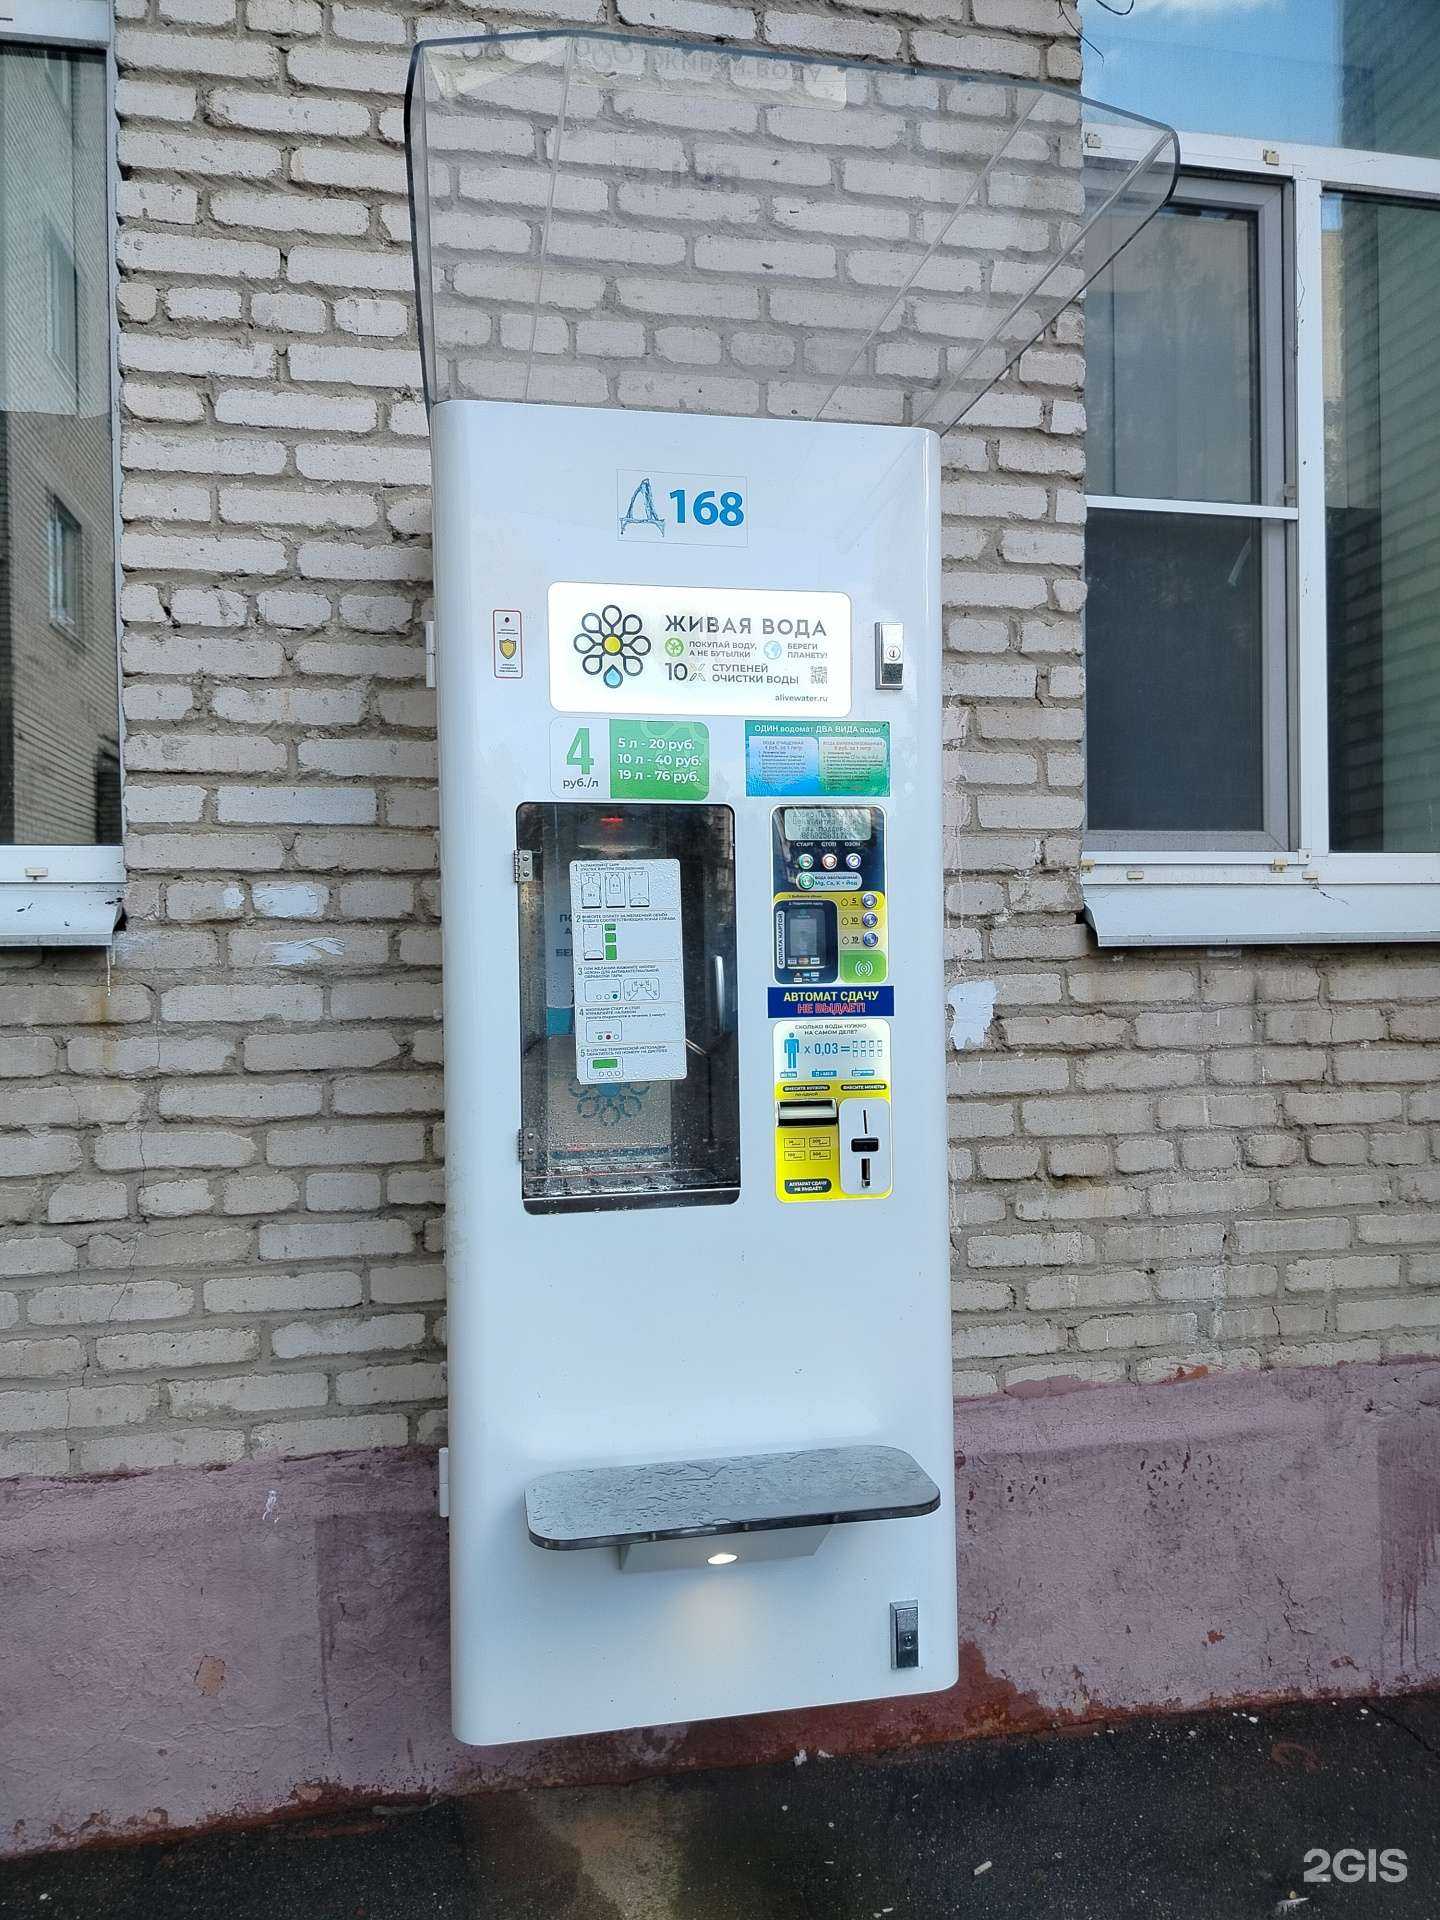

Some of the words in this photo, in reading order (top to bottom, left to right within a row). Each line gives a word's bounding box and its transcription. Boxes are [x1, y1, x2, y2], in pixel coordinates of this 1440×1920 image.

[669, 489, 744, 527] 168
[665, 614, 752, 634] ЖИВАЯ
[762, 618, 827, 639] ВОДА
[689, 640, 730, 649] ПОКУПАЙ
[732, 642, 758, 651] ВОДУ,
[787, 642, 818, 650] БЕРЕГИ
[710, 650, 751, 658] БУТЫЛКИ
[787, 651, 828, 659] ПЛАНЕТУ!
[712, 663, 768, 673] СТУПЕНЕЙ
[712, 674, 763, 683] ОЧИСТКИ
[766, 675, 799, 685] ВОДЫ
[775, 693, 829, 703] alivewater.ru
[754, 724, 779, 734] ОДИН
[815, 725, 833, 734] ДВА
[835, 725, 859, 734] ВИДА
[618, 737, 625, 748] 5
[629, 740, 637, 748] л
[649, 738, 666, 749] 20
[668, 738, 695, 750] руб.
[566, 727, 595, 775] 4
[617, 753, 632, 764] 10
[634, 755, 643, 764] л
[655, 754, 672, 765] 40
[675, 754, 702, 767] руб.
[618, 769, 632, 780] 19
[634, 771, 643, 780] л
[655, 770, 670, 781] 76
[673, 770, 700, 783] руб.
[563, 777, 599, 789] руб./л
[576, 914, 581, 922] 2
[577, 967, 583, 975] 3
[784, 991, 838, 1002] АВТОМАТ
[840, 990, 879, 1003] СДАЧУ
[579, 1008, 584, 1016] 4
[797, 1003, 814, 1013] НЕ
[580, 1049, 586, 1057] 5
[814, 1042, 838, 1056] 0,03
